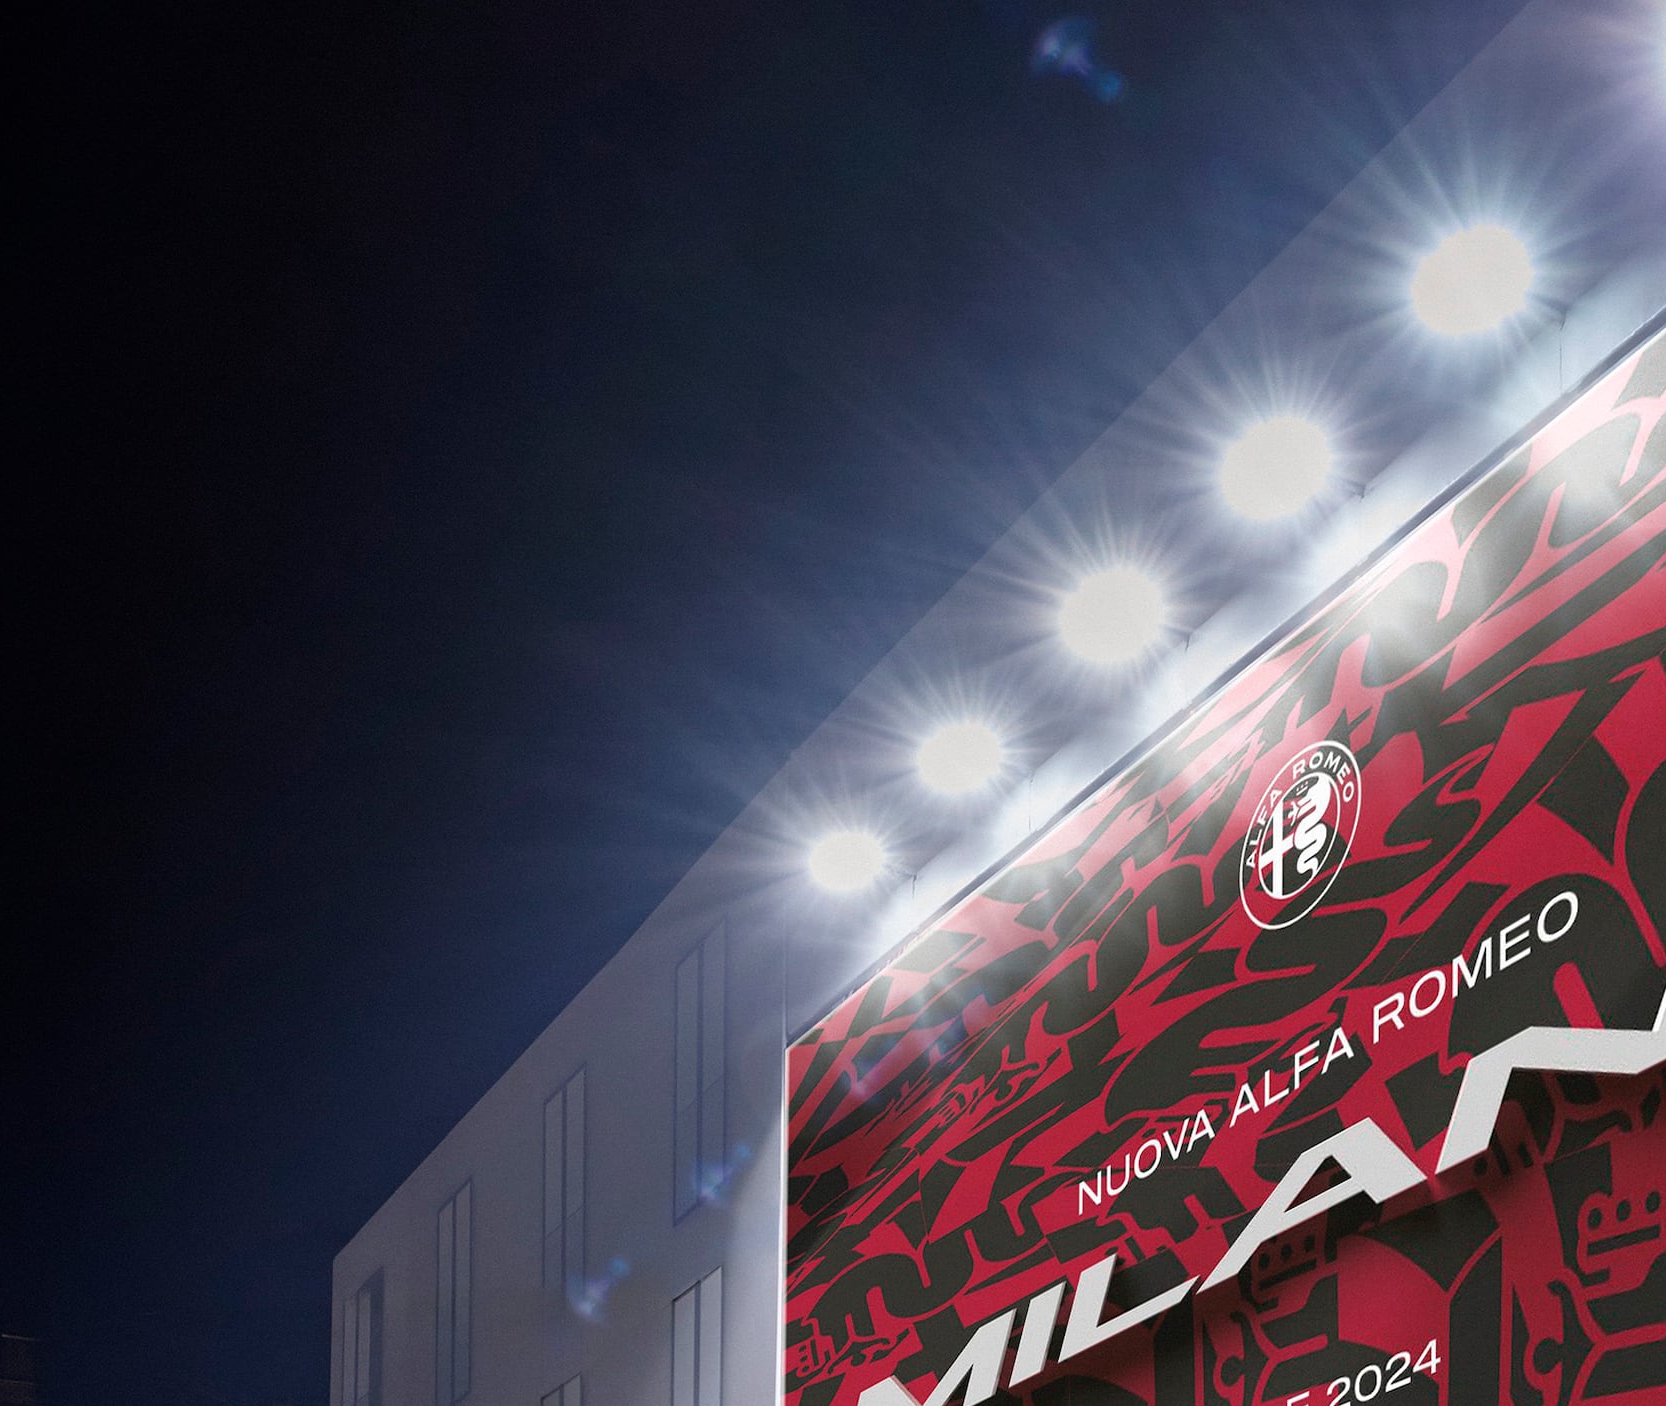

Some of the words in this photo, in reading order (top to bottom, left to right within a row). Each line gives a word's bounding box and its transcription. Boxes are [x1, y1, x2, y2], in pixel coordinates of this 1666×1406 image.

[1245, 787, 1284, 870] ALFA
[1291, 750, 1355, 803] ROMEO
[1077, 1109, 1216, 1216] NUOVA
[1228, 1026, 1355, 1128] ALFA
[1371, 891, 1579, 1044] ROMEO
